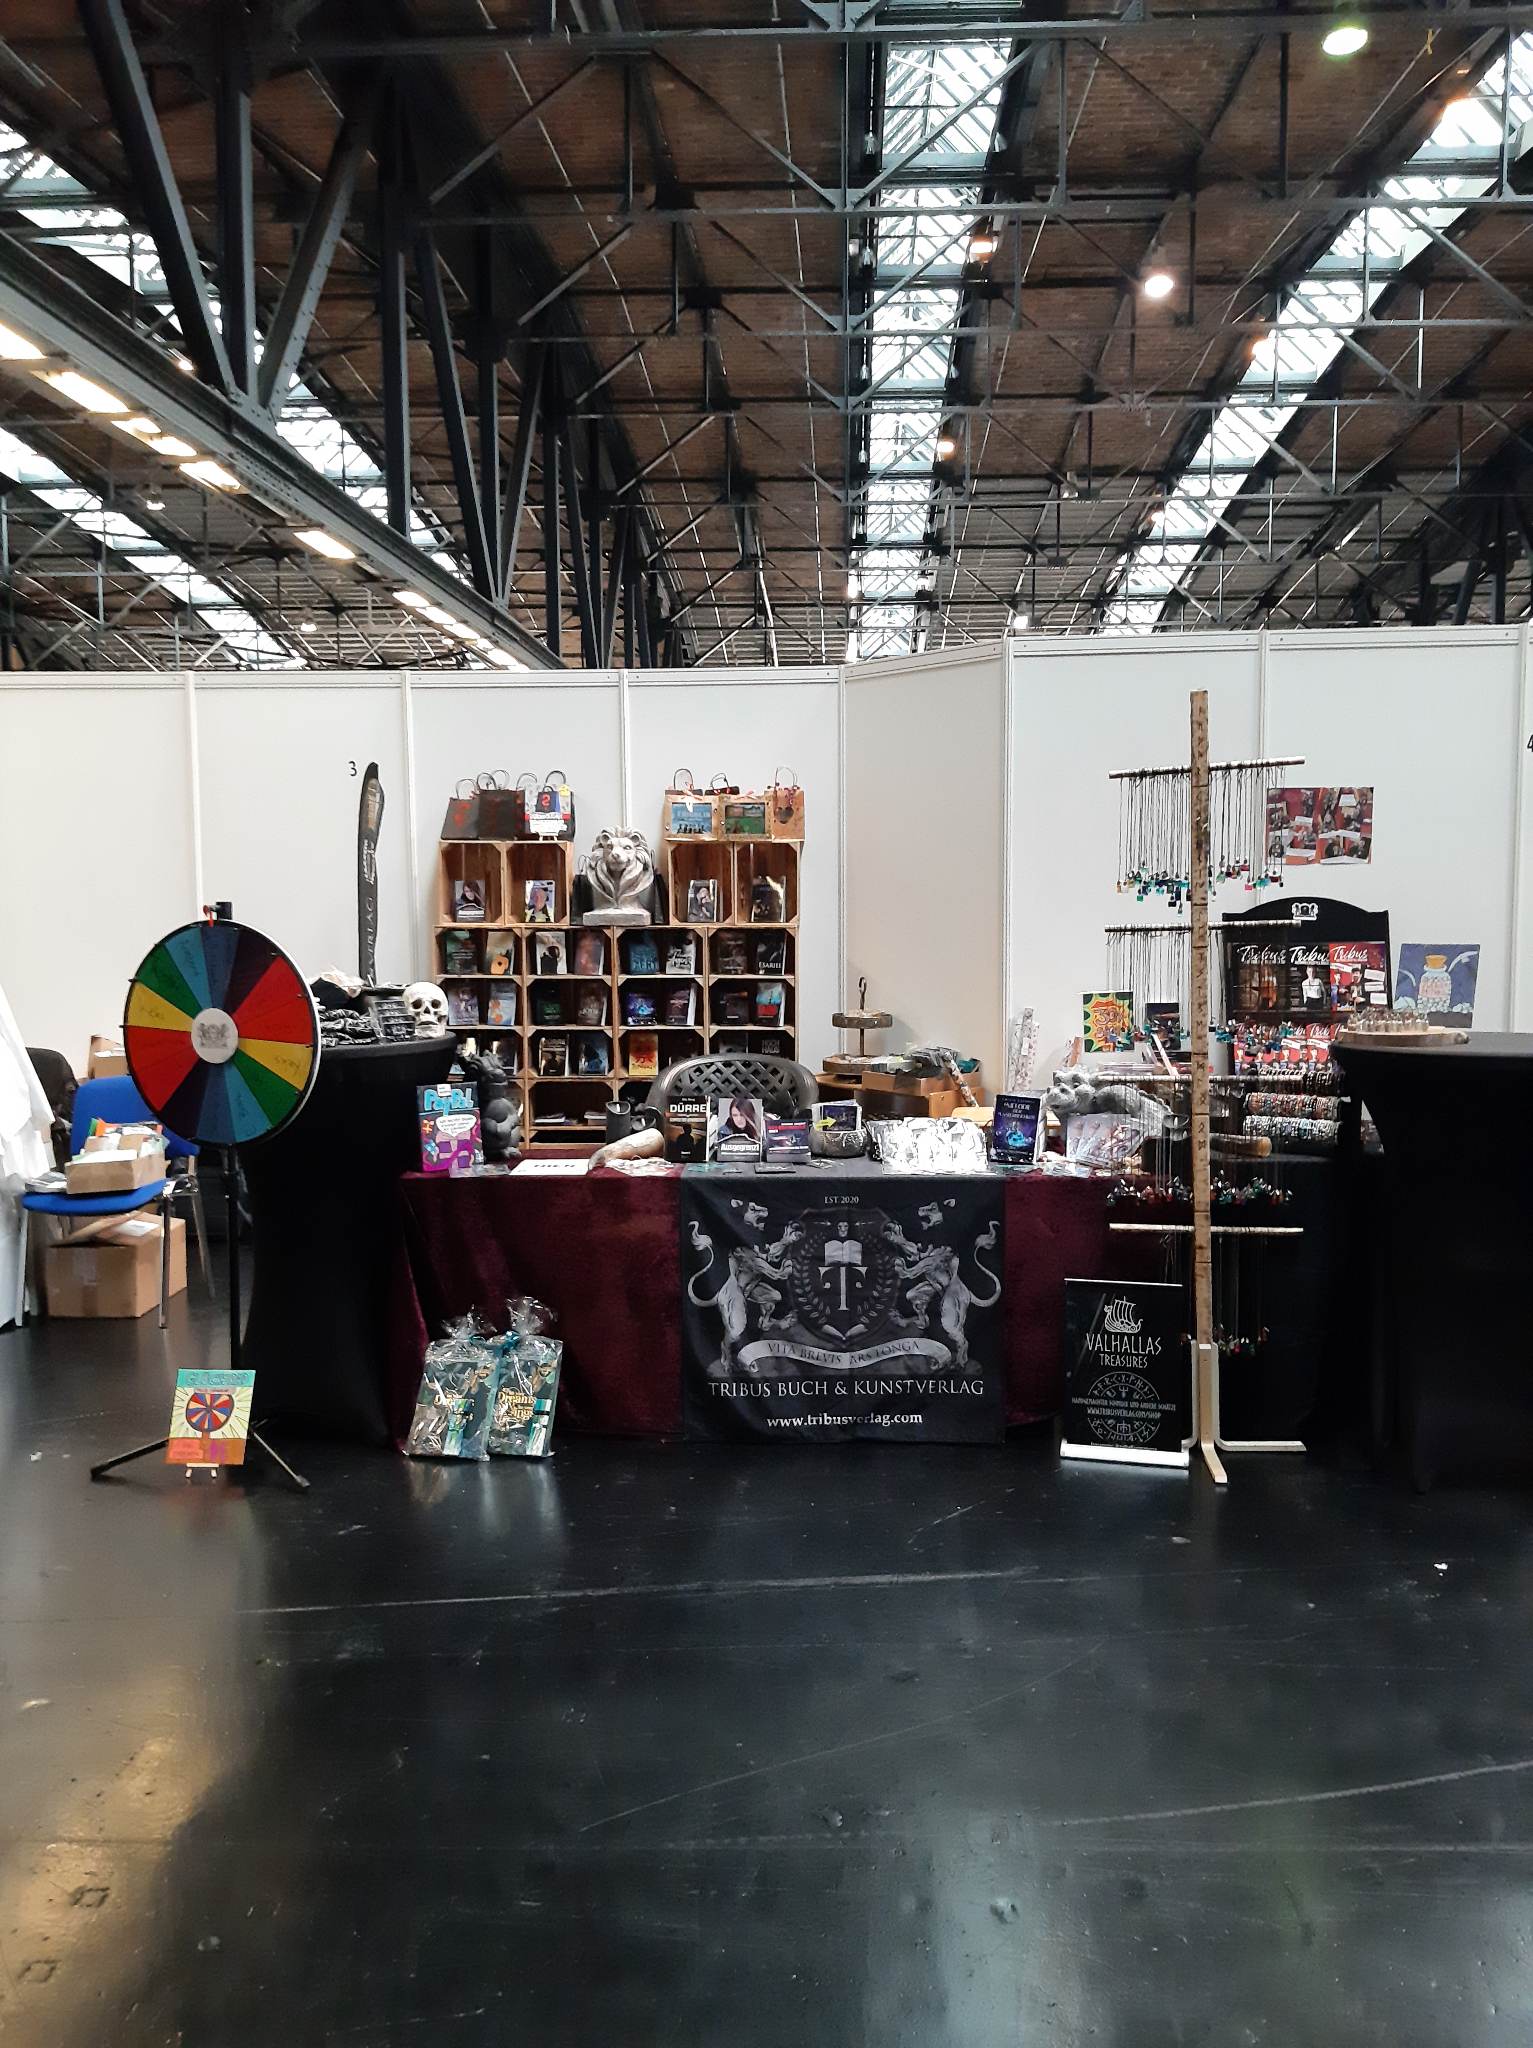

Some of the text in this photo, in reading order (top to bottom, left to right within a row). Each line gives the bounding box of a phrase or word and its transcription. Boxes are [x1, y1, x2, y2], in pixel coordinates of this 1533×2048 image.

[348, 761, 358, 777] 3
[1330, 944, 1368, 961] Tribus
[670, 1102, 707, 1113] DÜRRE
[840, 1195, 860, 1204] 2020
[1086, 1333, 1162, 1355] VALHALLAS
[767, 1341, 920, 1366] VITA BREVIS ARS LONGA
[1099, 1353, 1148, 1368] TREASURES
[708, 1379, 984, 1397] TRIBUS BUCH & KUNSTVERLAG
[767, 1412, 923, 1427] www.tribusverlag.com
